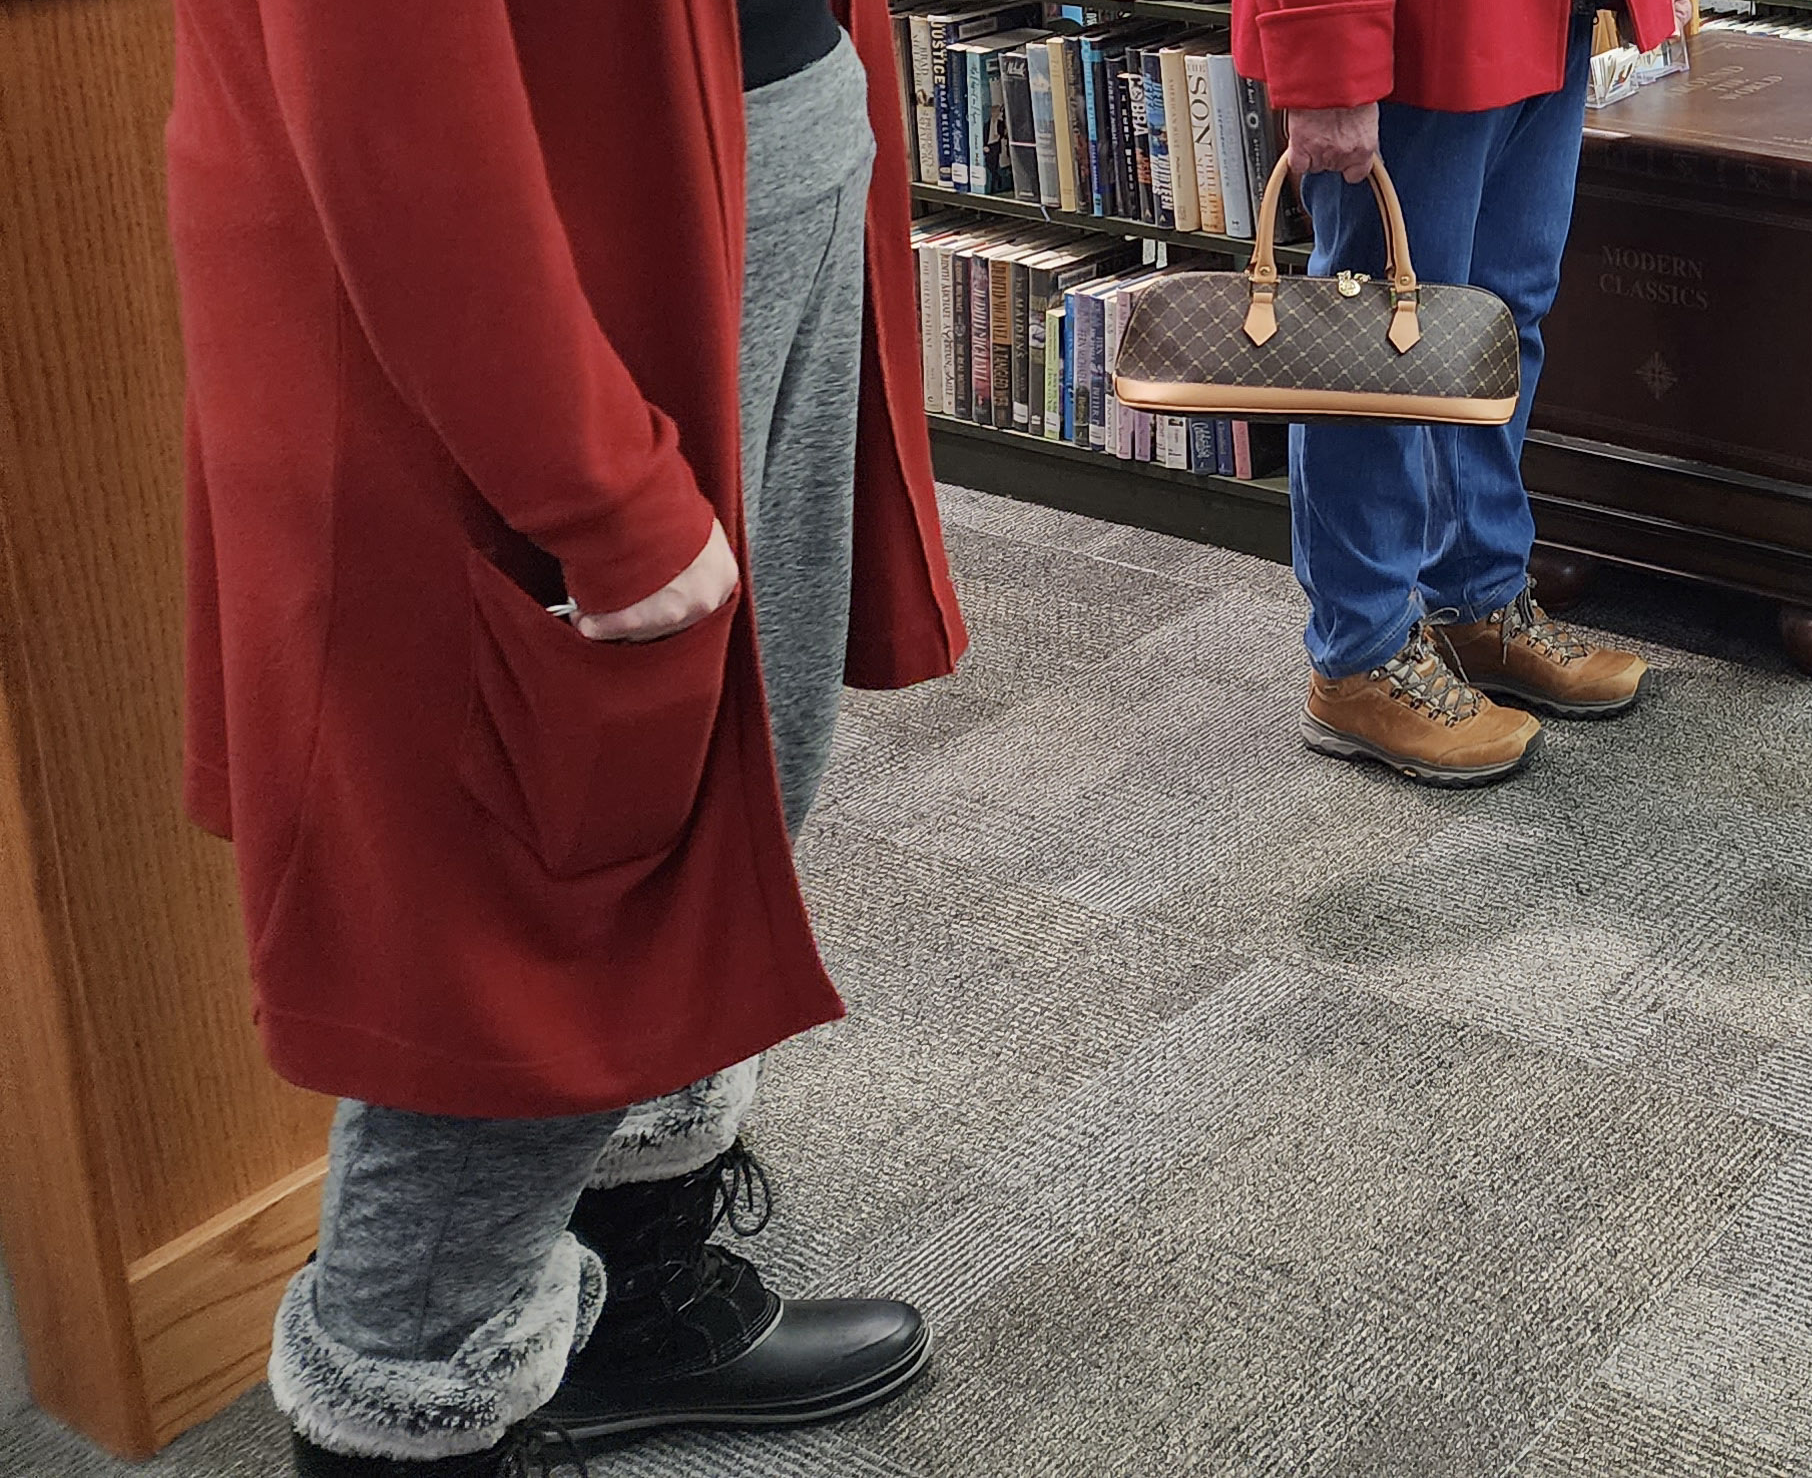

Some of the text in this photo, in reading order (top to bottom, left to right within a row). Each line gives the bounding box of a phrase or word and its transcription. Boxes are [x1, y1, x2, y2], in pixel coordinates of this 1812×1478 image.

[931, 21, 946, 85] JUSTICE
[1128, 73, 1148, 136] COBRA
[1188, 74, 1213, 151] SON
[1600, 273, 1708, 311] CLASSICS
[1601, 245, 1703, 280] MODERN
[1015, 297, 1027, 359] MAIDENS
